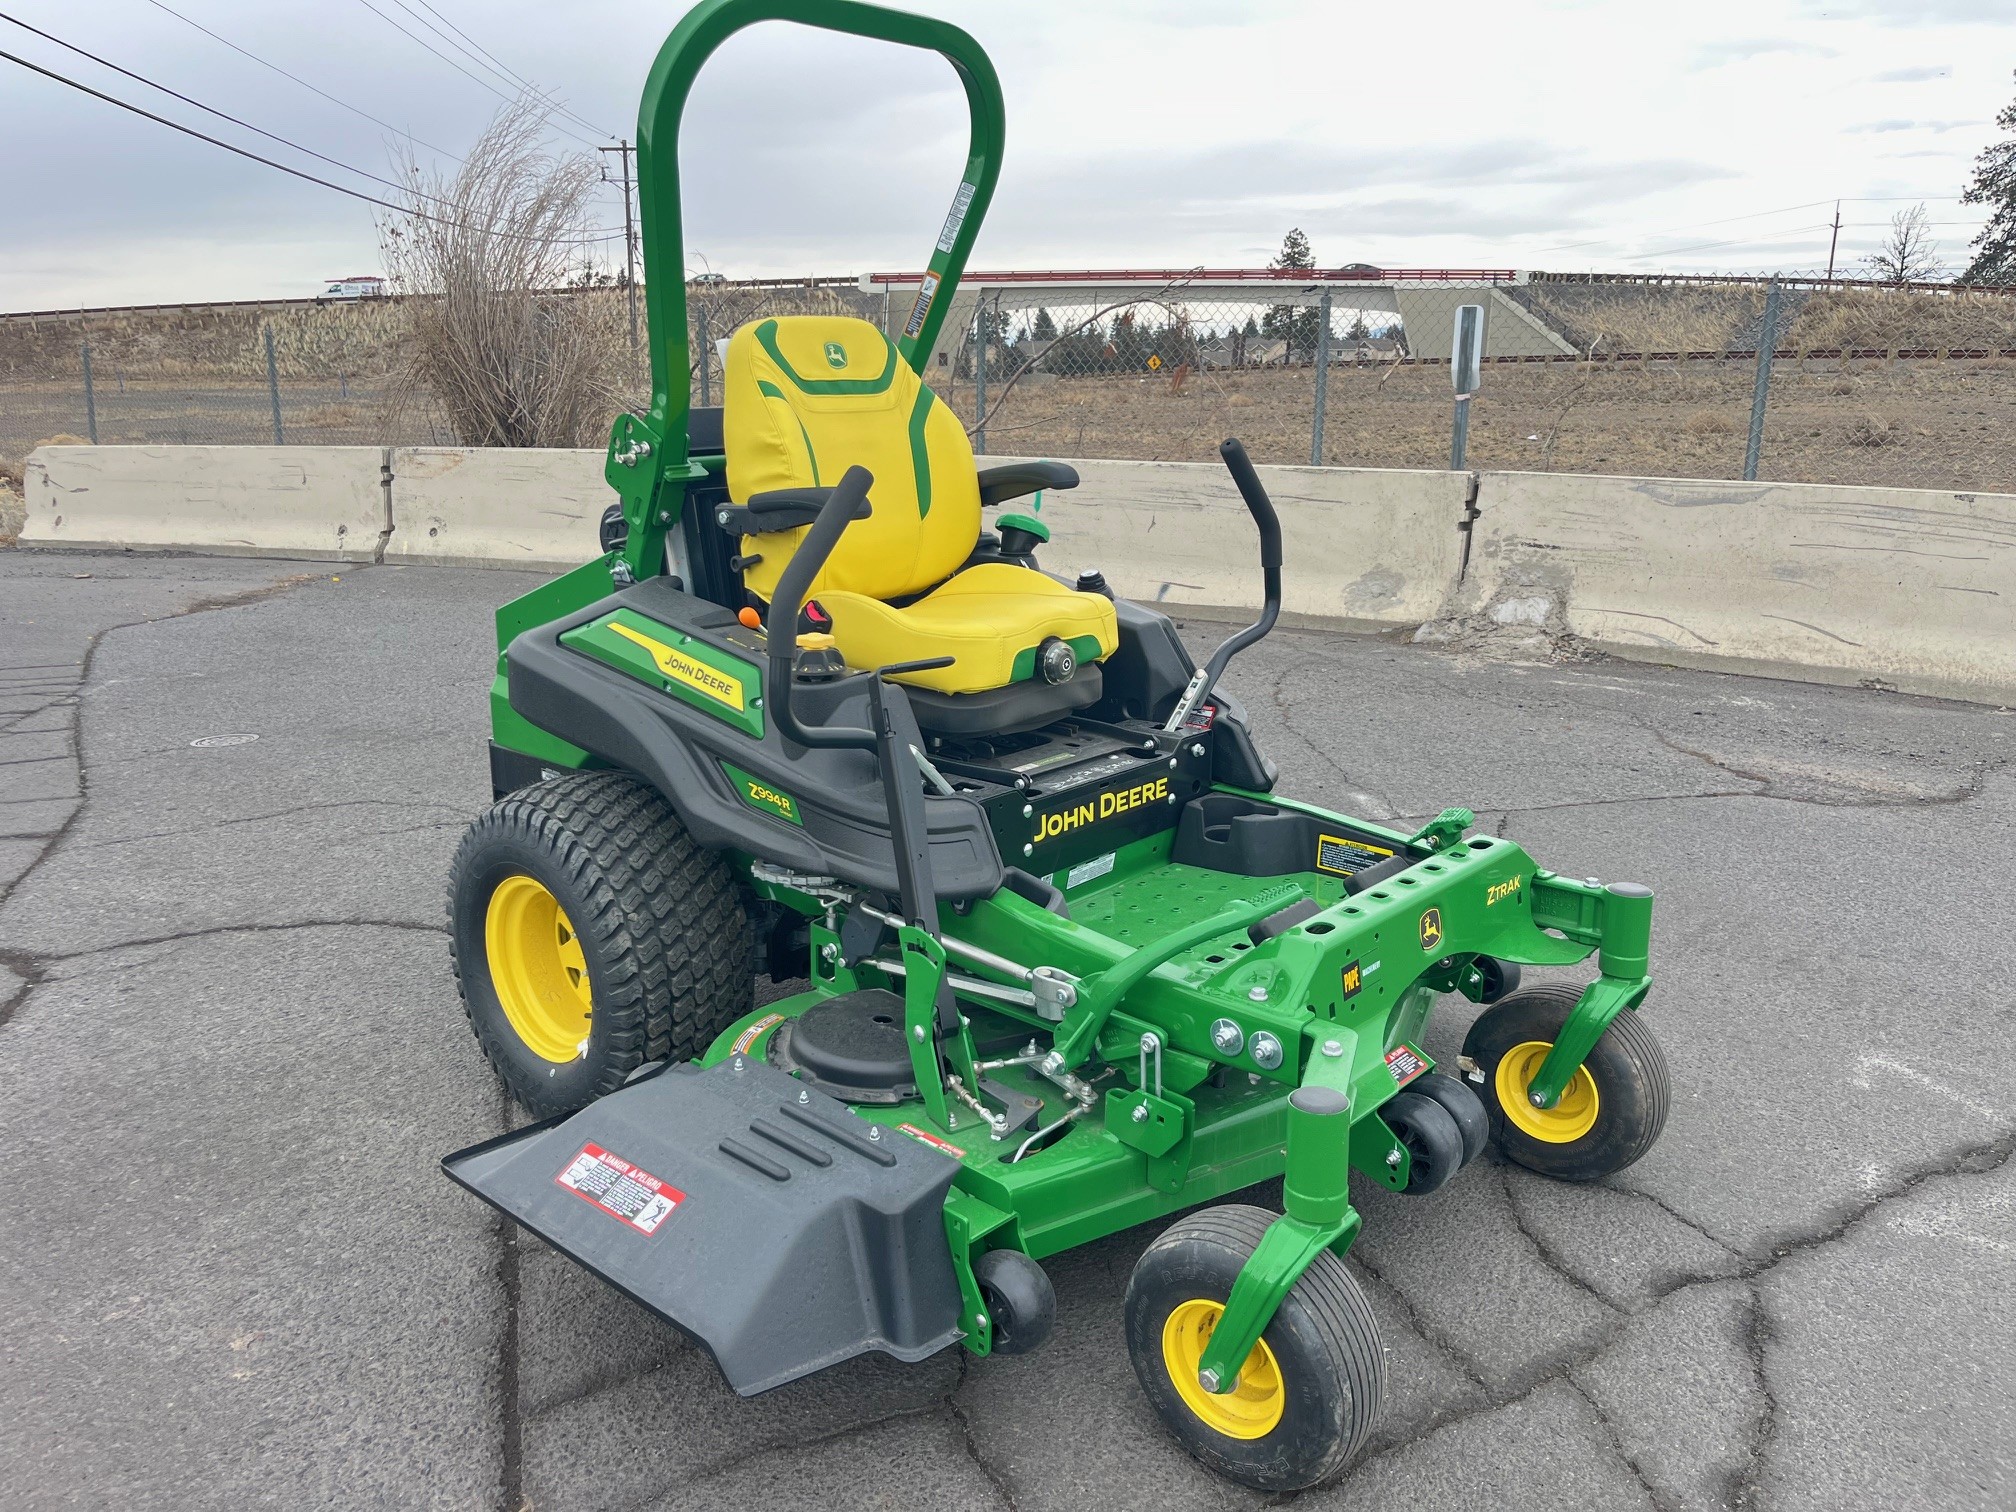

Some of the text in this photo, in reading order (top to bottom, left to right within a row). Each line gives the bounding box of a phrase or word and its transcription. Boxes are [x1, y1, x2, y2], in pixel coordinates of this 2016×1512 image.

[664, 654, 733, 696] JOHN DEERE
[748, 781, 791, 810] Z994R
[1033, 777, 1168, 843] JOHN DEERE
[1486, 873, 1521, 906] ZTRAK
[604, 1154, 663, 1191] DANGER PELIGRO
